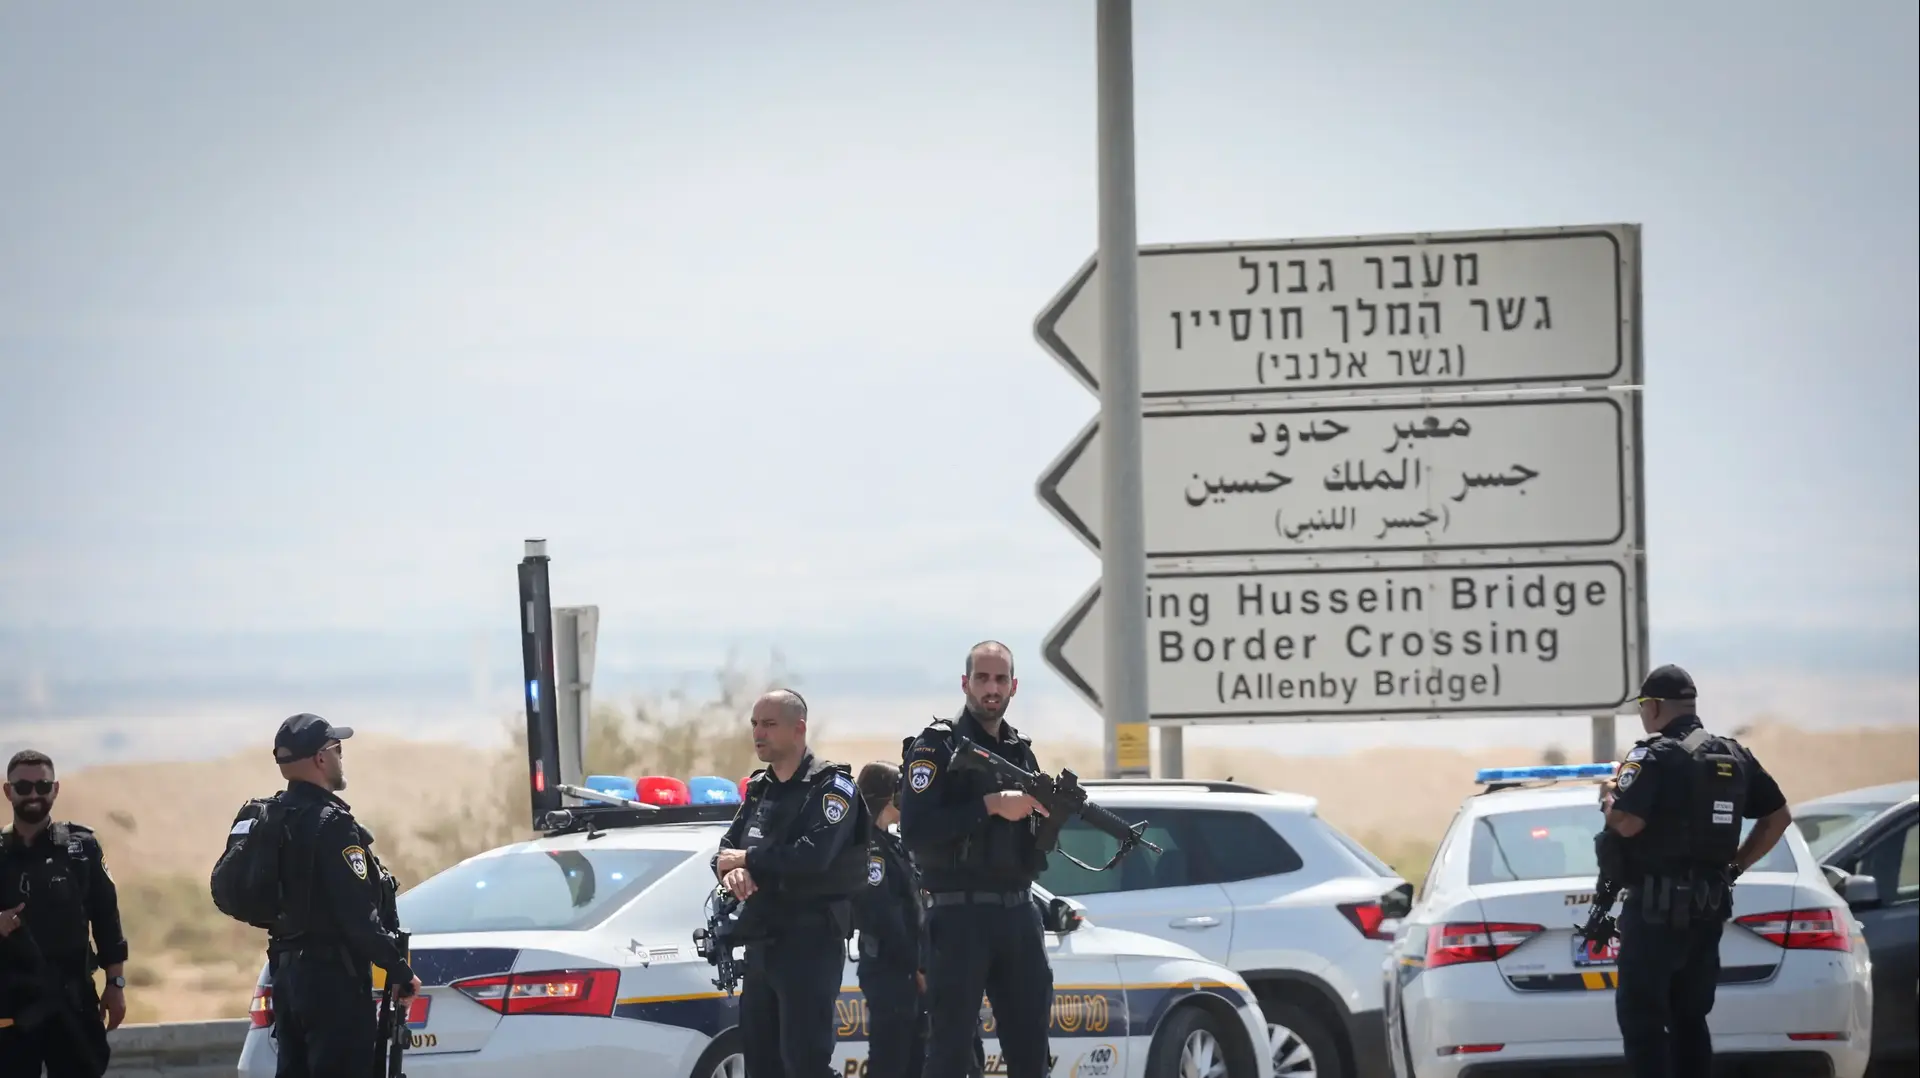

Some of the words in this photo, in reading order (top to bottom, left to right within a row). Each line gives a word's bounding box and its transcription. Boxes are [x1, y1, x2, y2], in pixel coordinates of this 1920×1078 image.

[1239, 255, 1336, 295] גבול
[1364, 252, 1479, 290] מעבר
[1170, 306, 1303, 350] חוסיין
[1331, 297, 1441, 343] המלך
[1469, 295, 1552, 332] גשר
[1256, 347, 1368, 385] אלנבי)
[1386, 344, 1466, 378] (גשר
[1250, 419, 1350, 456] حدود
[1383, 416, 1472, 453] معبر
[1185, 470, 1294, 508] حسين
[1323, 457, 1421, 492] الملك
[1450, 464, 1540, 502] جسر
[1374, 503, 1451, 540] (جسر
[1145, 586, 1210, 627] ing
[1237, 580, 1423, 617] Hussein
[1450, 574, 1607, 617] Bridge
[1159, 627, 1317, 663] Border
[1345, 622, 1559, 663] Crossing
[1217, 671, 1358, 704] (Allenby
[1374, 663, 1501, 702] Bridge)
[1091, 1048, 1112, 1063] 100
